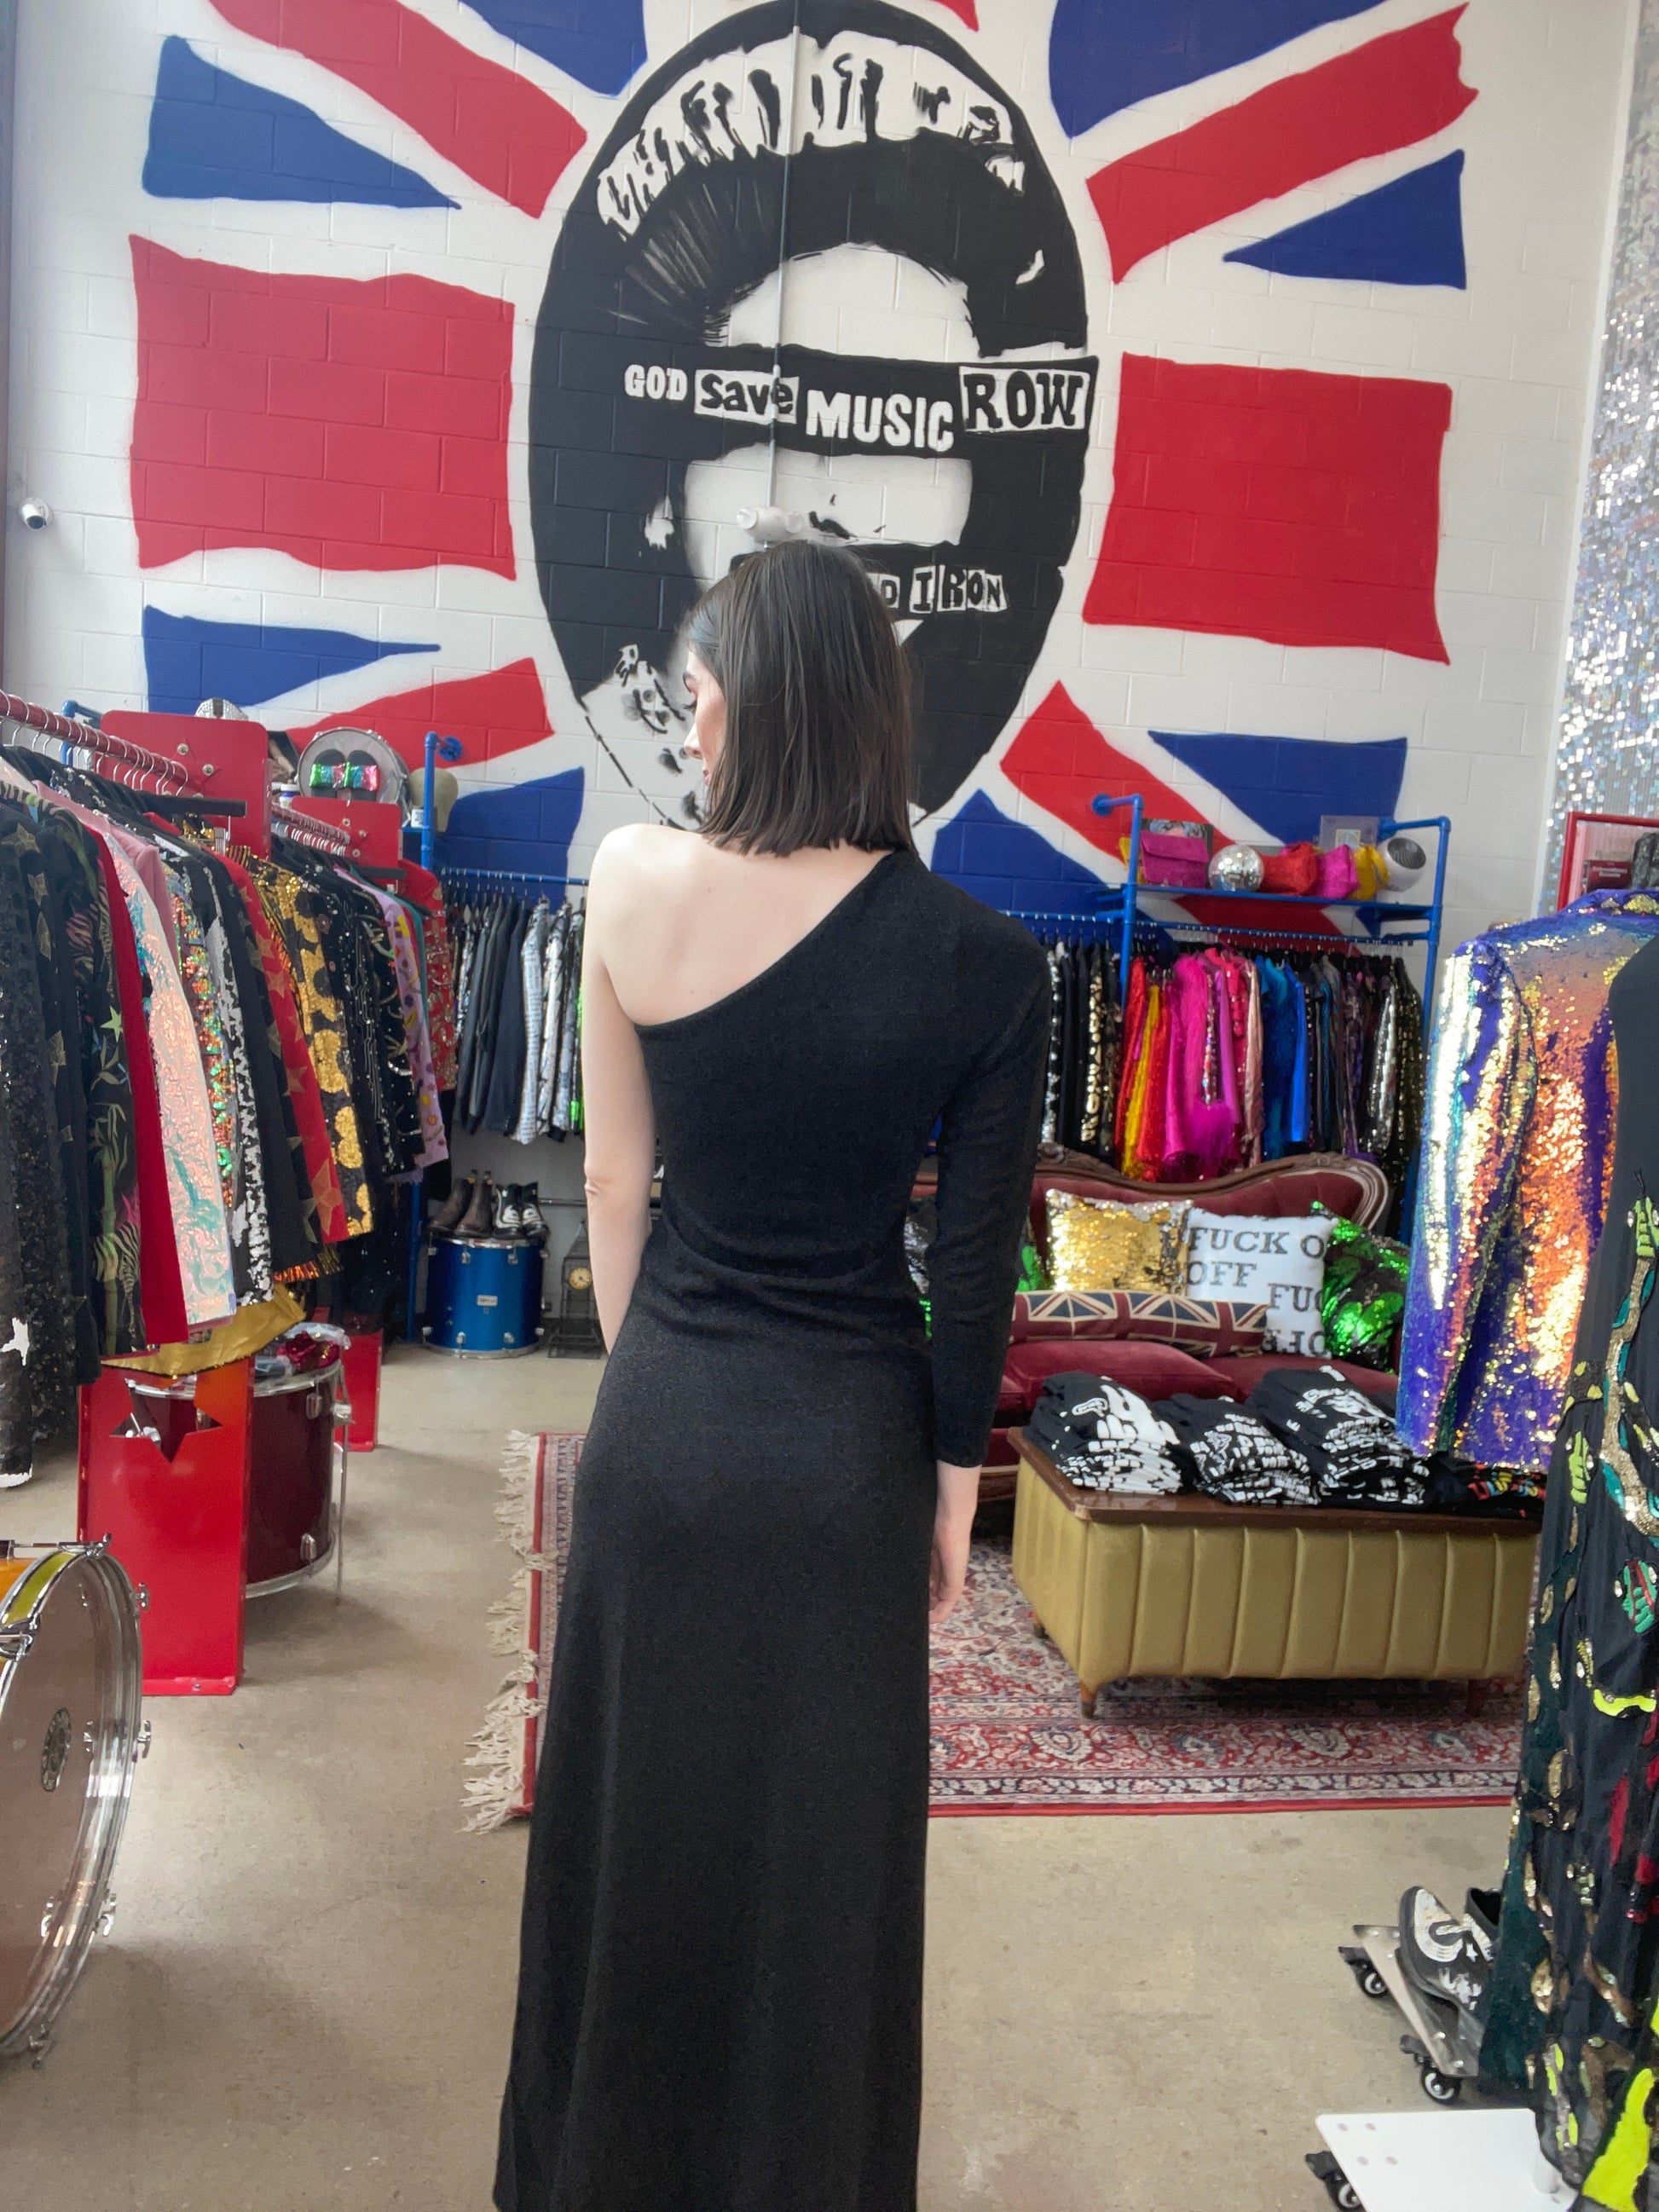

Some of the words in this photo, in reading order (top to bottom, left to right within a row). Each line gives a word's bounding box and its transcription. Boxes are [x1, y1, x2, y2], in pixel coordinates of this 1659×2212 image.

[624, 364, 688, 401] GOD
[806, 389, 955, 452] MUSIC
[962, 370, 1084, 430] ROW
[912, 565, 1003, 612] IRON
[1189, 1227, 1290, 1255] FUCK
[1187, 1261, 1257, 1288] OFF
